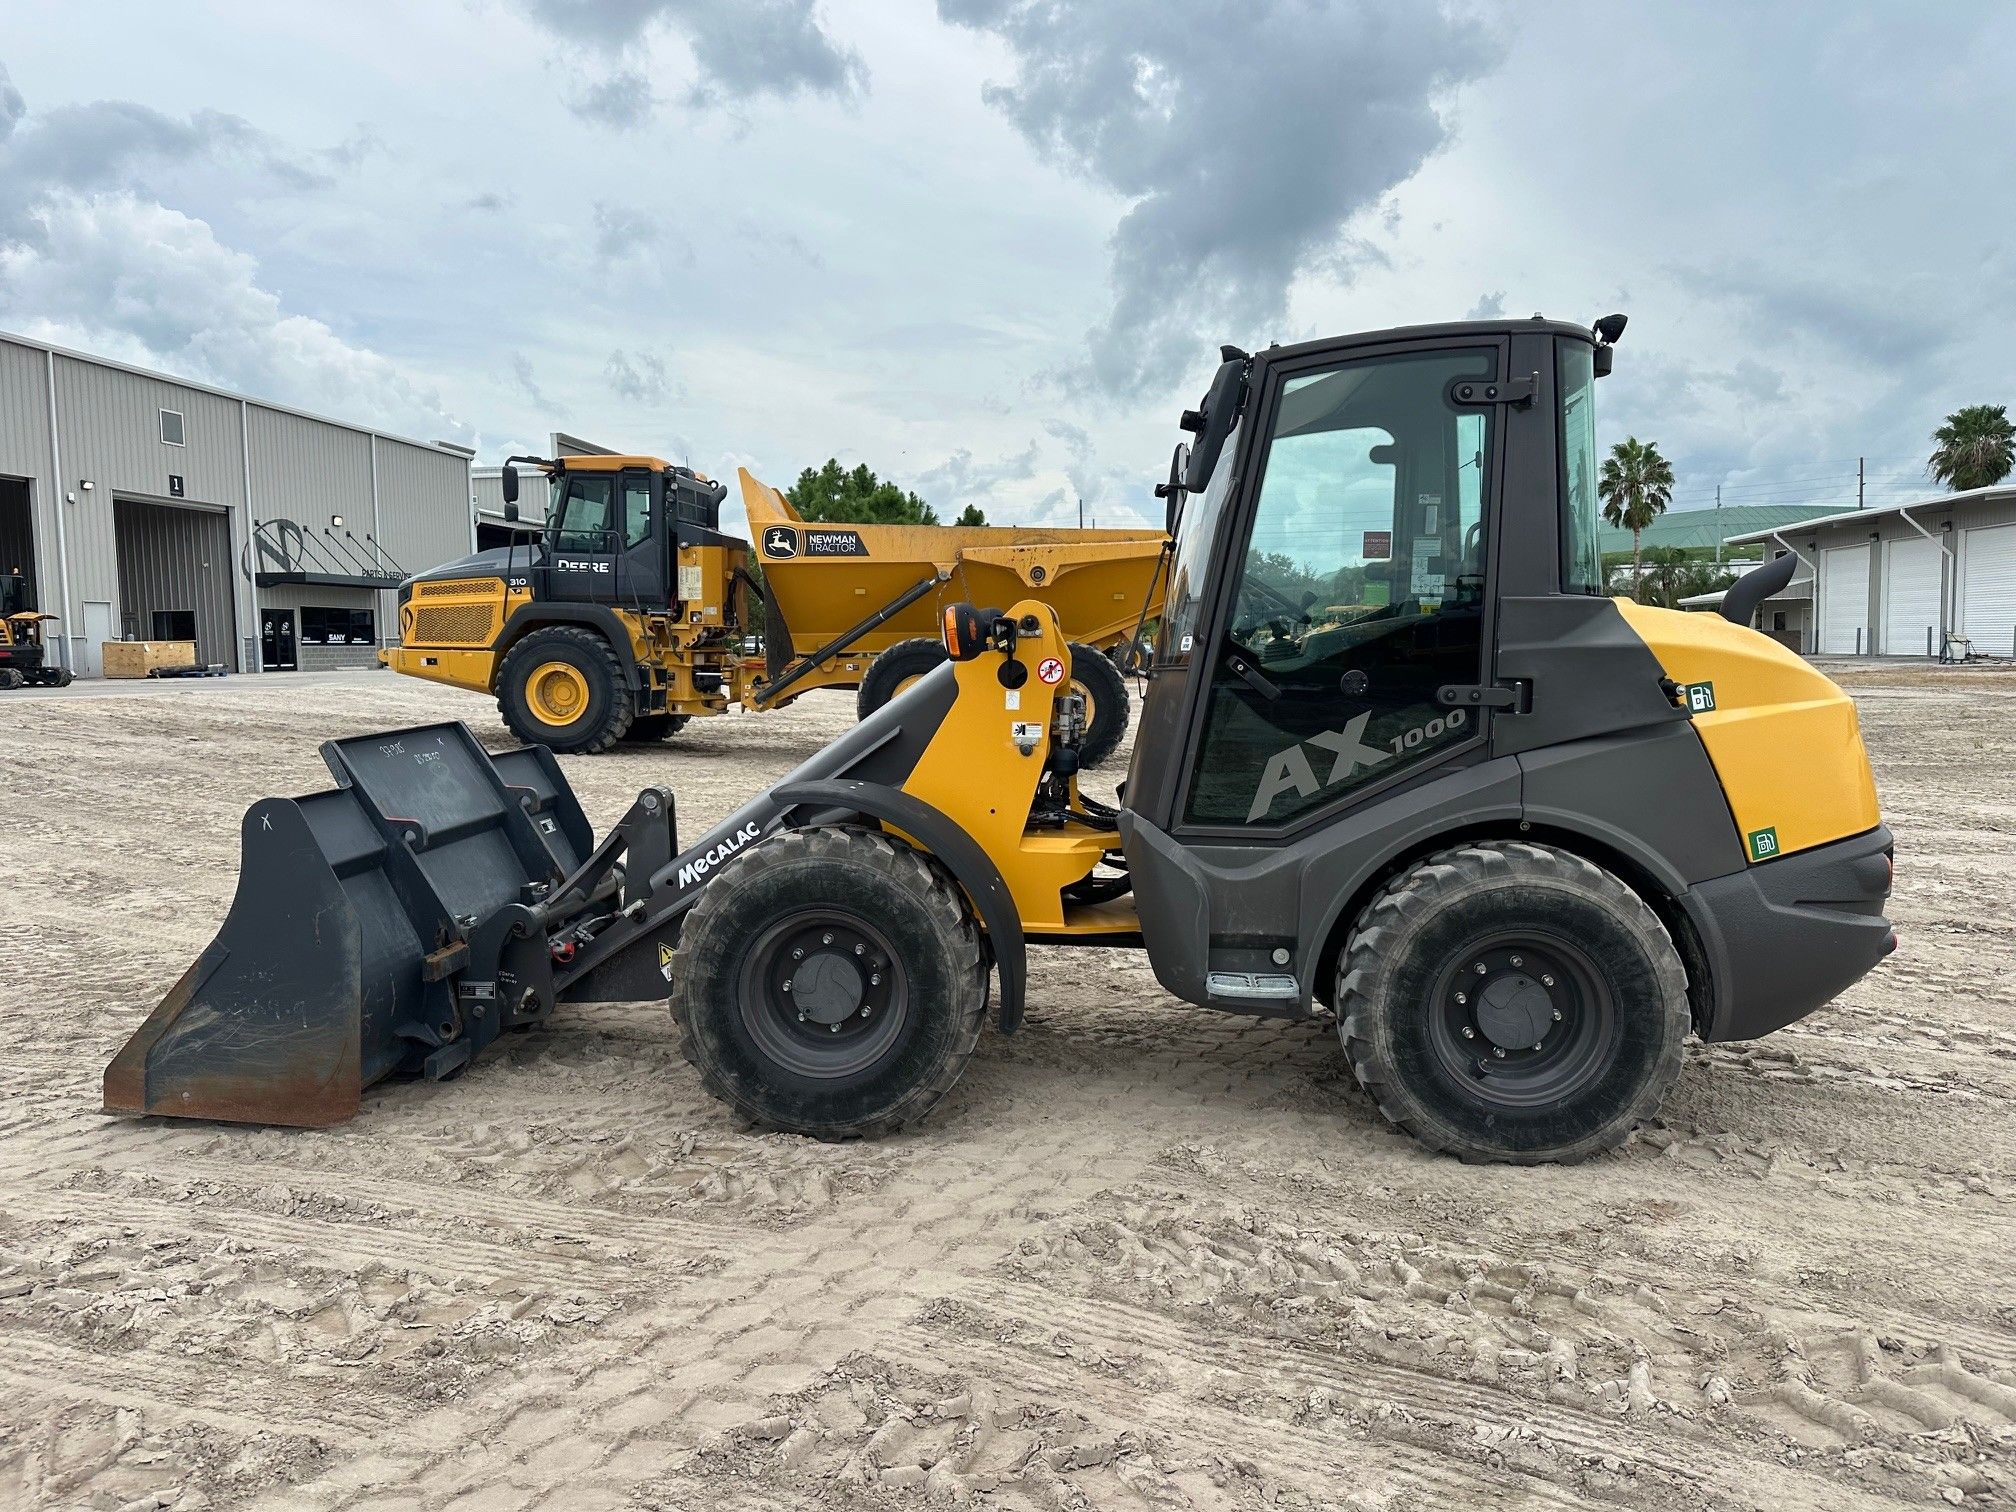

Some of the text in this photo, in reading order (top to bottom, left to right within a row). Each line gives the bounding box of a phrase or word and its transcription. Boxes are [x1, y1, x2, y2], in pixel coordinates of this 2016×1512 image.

[174, 478, 179, 490] 1
[809, 535, 856, 544] NEWMAN
[810, 543, 856, 552] TRACTOR
[558, 560, 610, 573] DEERE
[361, 570, 382, 579] PARTS
[509, 578, 527, 586] 310
[1695, 697, 1701, 705] D
[1389, 708, 1466, 754] 1000
[1246, 709, 1393, 824] AX
